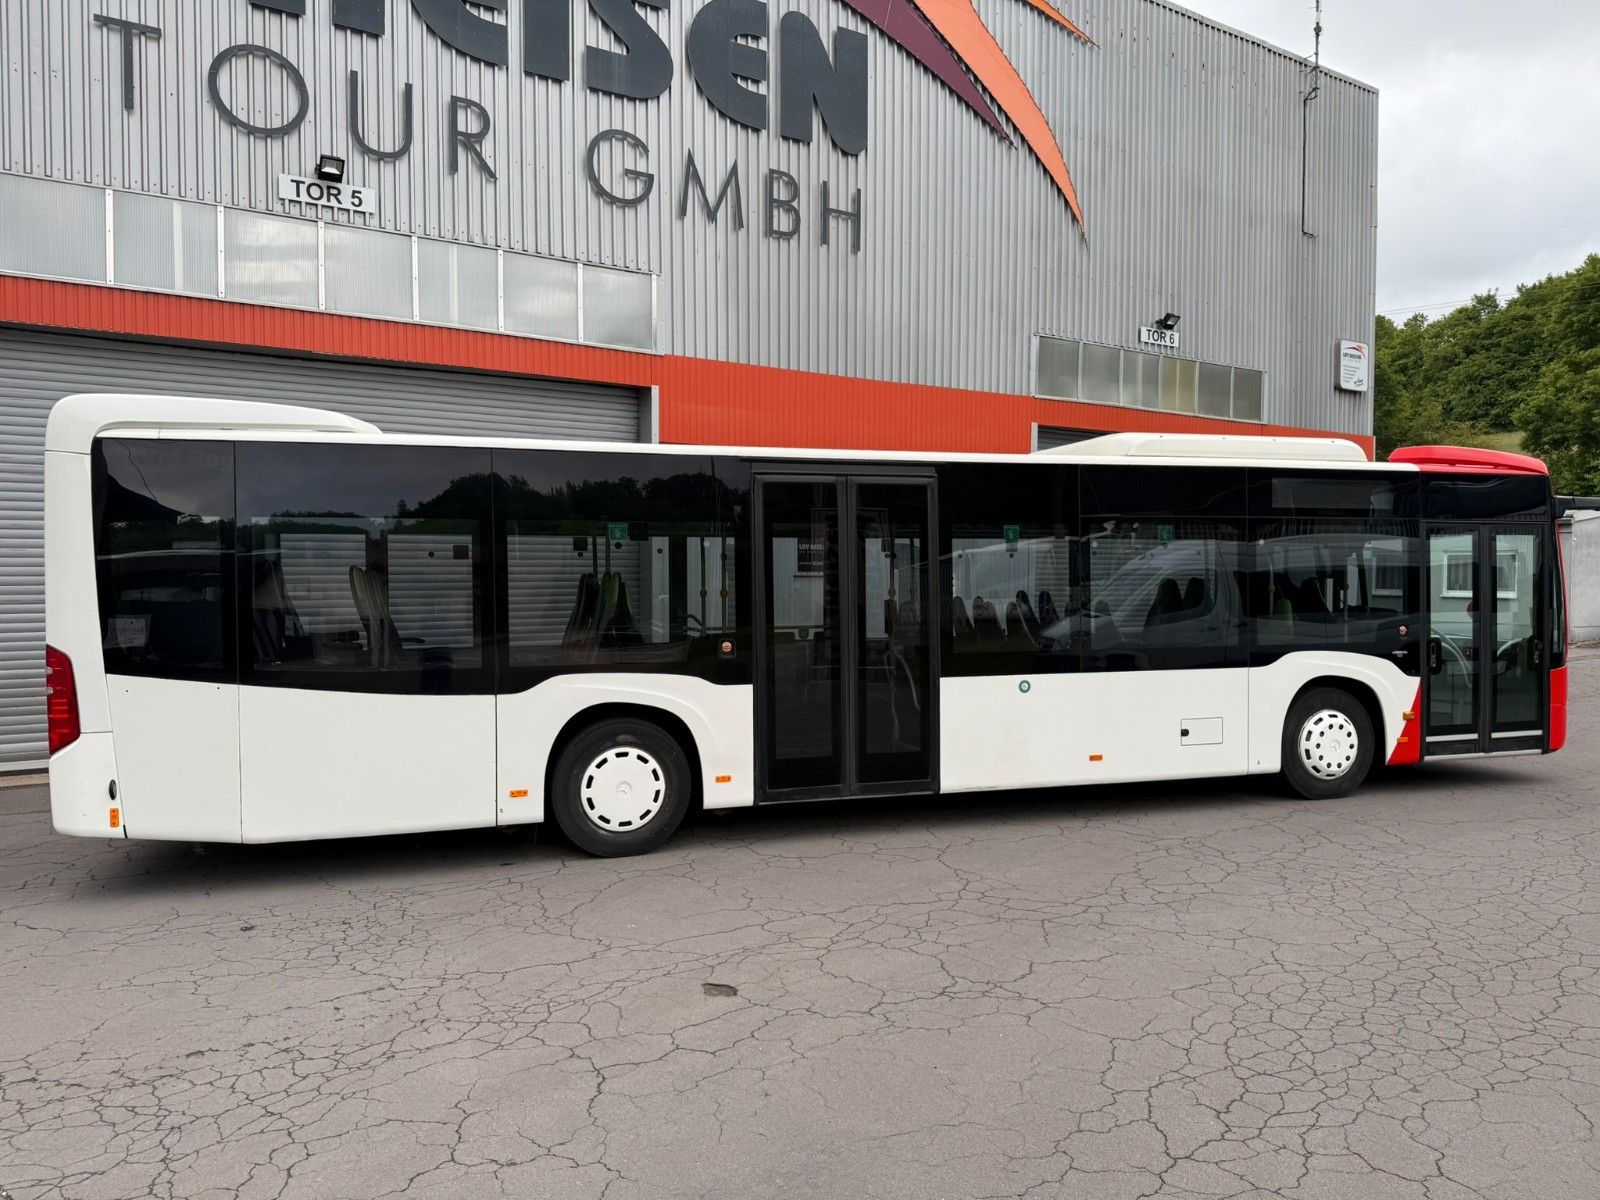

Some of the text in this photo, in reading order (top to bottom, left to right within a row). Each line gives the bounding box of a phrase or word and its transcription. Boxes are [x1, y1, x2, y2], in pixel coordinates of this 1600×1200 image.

[93, 13, 861, 252] TOUR GMBH
[290, 179, 363, 208] TOR 5
[1146, 329, 1175, 345] TOR 6
